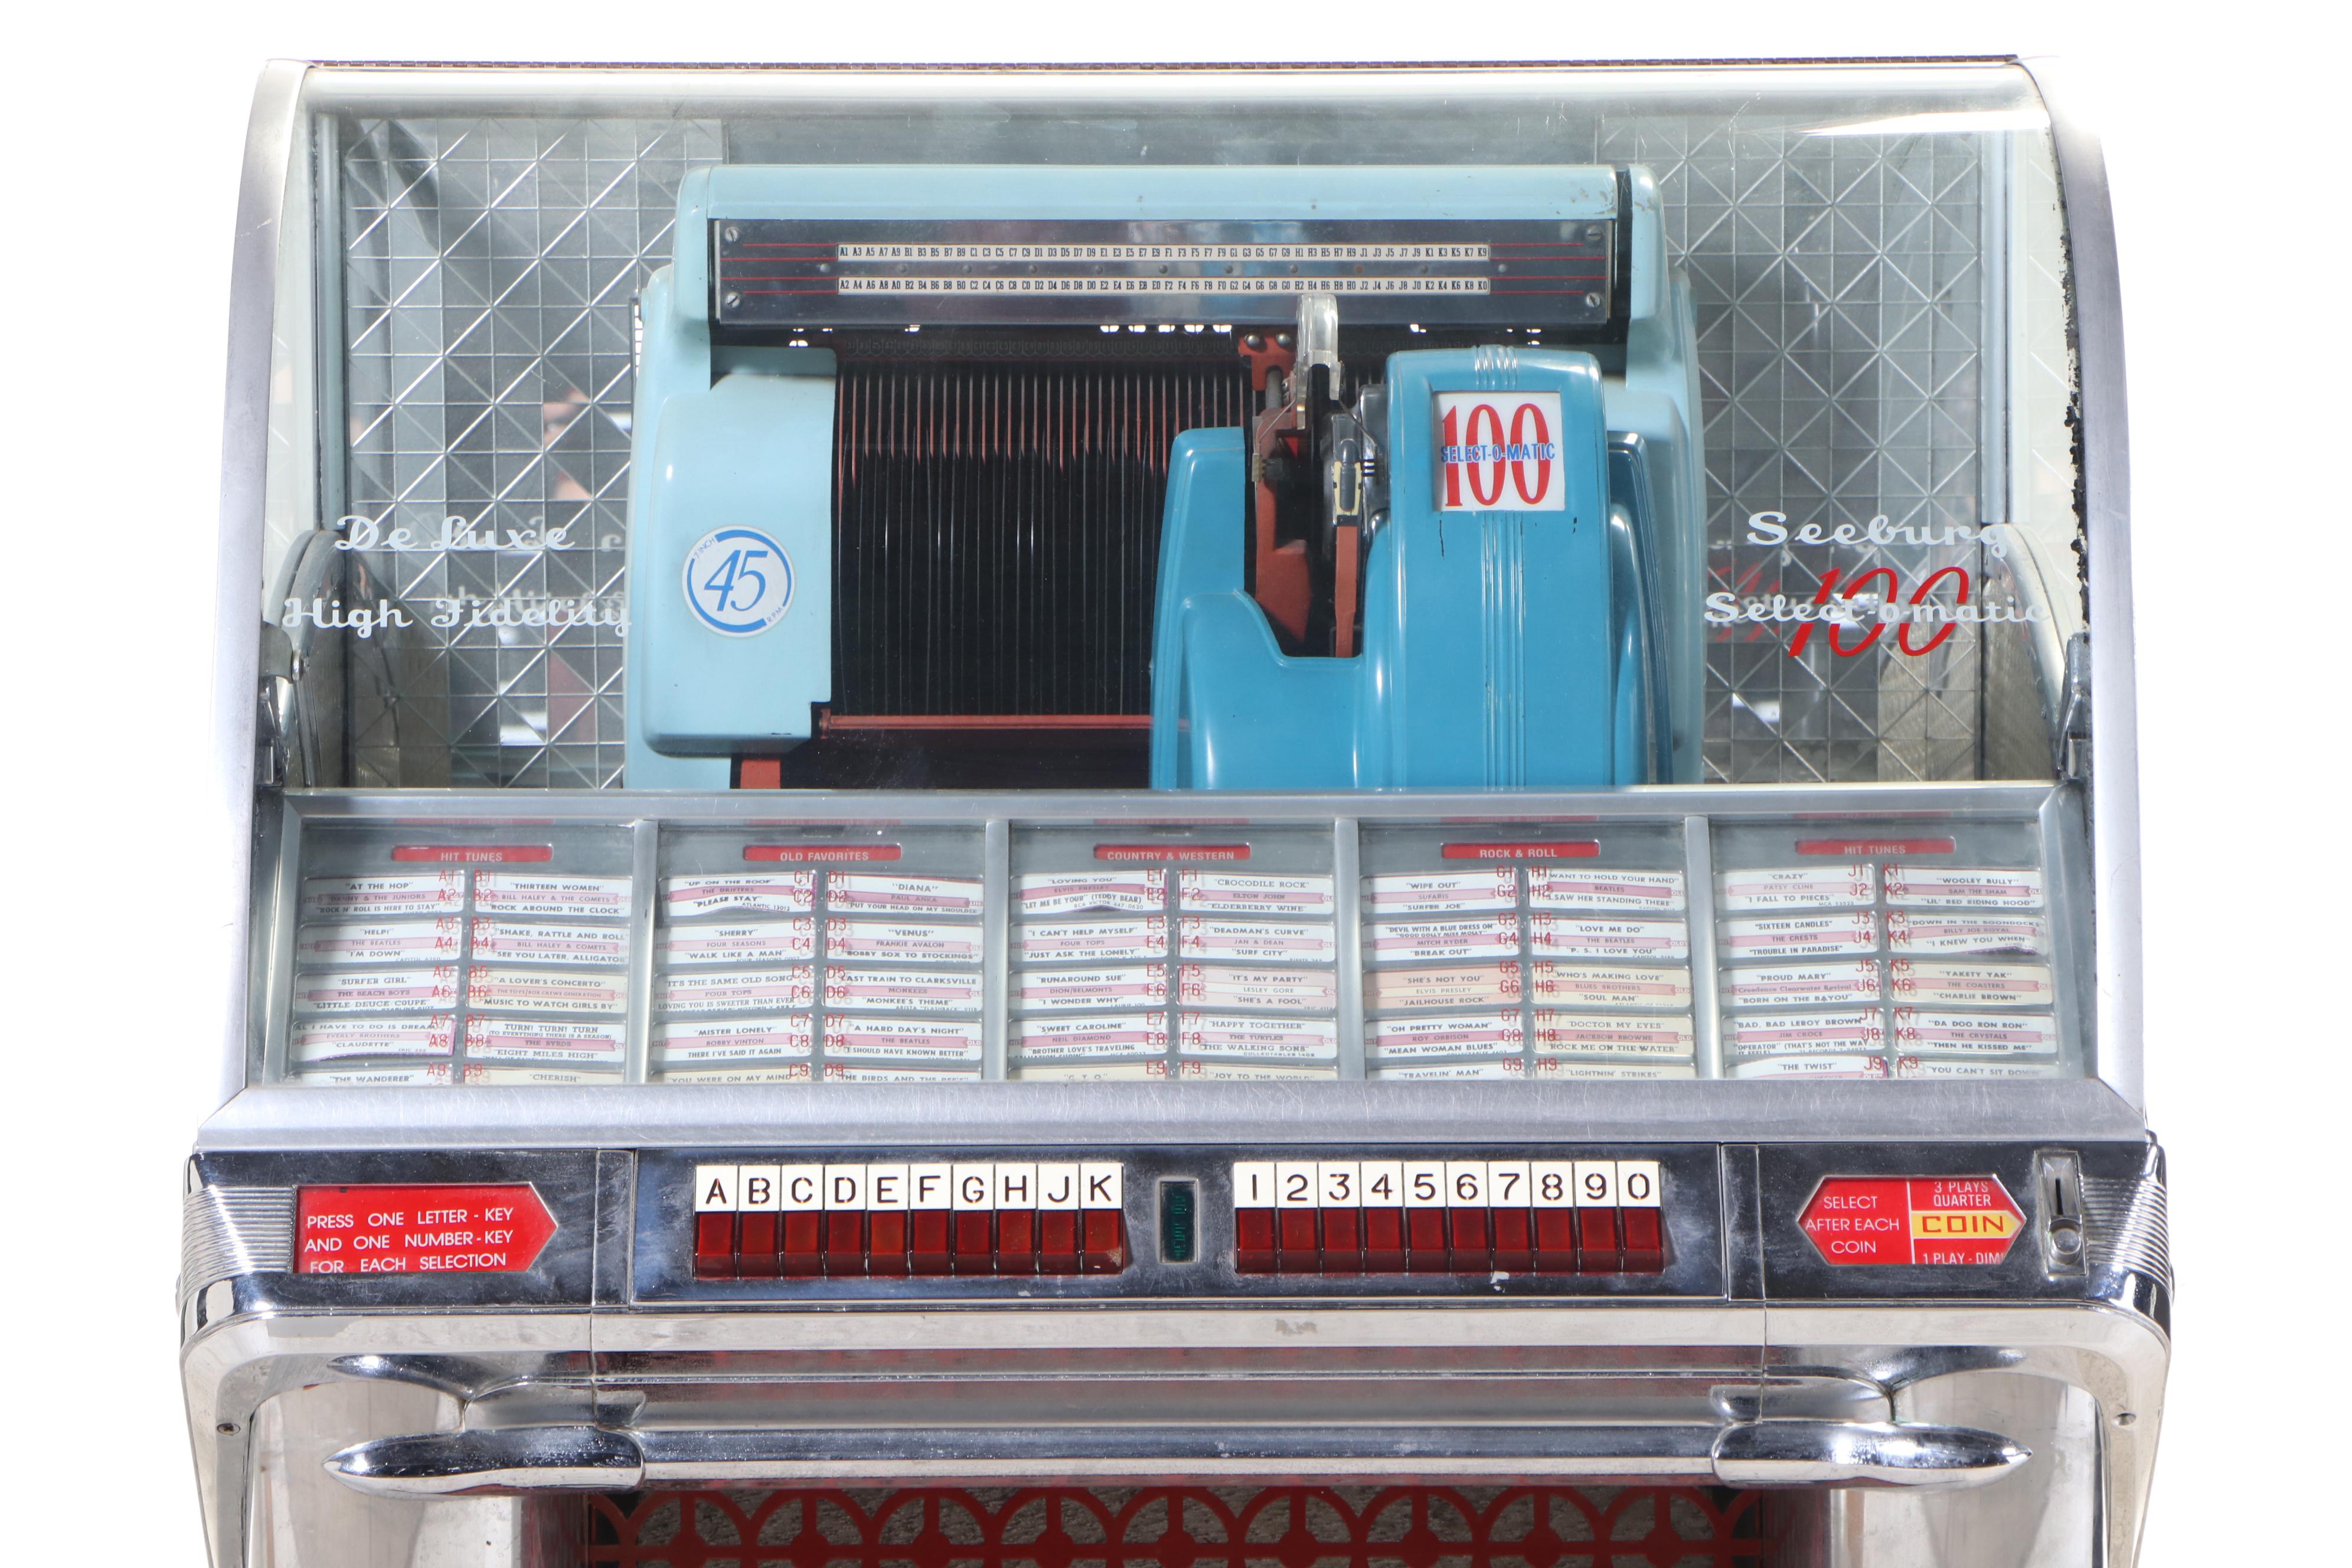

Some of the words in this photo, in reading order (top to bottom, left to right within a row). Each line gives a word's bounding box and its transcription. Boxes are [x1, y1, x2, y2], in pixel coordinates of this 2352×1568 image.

[840, 247, 848, 256] A1
[853, 247, 861, 256] A3
[866, 247, 874, 256] A5
[880, 247, 888, 256] A7
[892, 247, 900, 256] A9
[905, 248, 912, 256] B1
[918, 248, 926, 256] B3
[931, 248, 939, 257] B5
[1373, 281, 1381, 290] J4
[1386, 281, 1394, 290] J6
[1399, 281, 1407, 290] J8
[1412, 281, 1421, 290] J0
[1426, 281, 1435, 290] K2
[1439, 281, 1447, 290] K4
[1452, 281, 1461, 290] K6
[1465, 281, 1474, 290] K8
[1478, 281, 1487, 290] K0
[1441, 443, 1555, 462] SELECT-O-MATIC
[1442, 403, 1550, 507] 100
[431, 515, 575, 550] Luxe
[1747, 511, 2007, 558] Seeburg
[704, 550, 768, 611] 45
[283, 597, 413, 639] High
[431, 595, 632, 637] Fidelity
[1788, 567, 1969, 658] 100
[441, 852, 462, 862] HIT
[465, 852, 502, 862] TUNES
[780, 852, 803, 861] OLD
[808, 852, 868, 861] FAVORITES
[1108, 851, 1161, 860] COUNTRY
[1167, 851, 1174, 860] &
[1180, 852, 1234, 860] WESTERN
[1480, 850, 1510, 858] ROCK
[1516, 849, 1523, 857] &
[1528, 848, 1557, 857] ROLL
[1844, 846, 1866, 854] HIT
[1870, 846, 1906, 854] TUNES
[534, 1050, 564, 1059] MILES
[706, 1178, 727, 1204] A
[749, 1178, 770, 1204] B
[791, 1178, 813, 1203] C
[835, 1177, 857, 1203] D
[877, 1177, 898, 1203] E
[920, 1176, 941, 1202] F
[962, 1177, 984, 1203] G
[1005, 1176, 1027, 1202] H
[1047, 1176, 1069, 1202] J
[1090, 1176, 1112, 1202] K
[1252, 1175, 1256, 1201] 1
[1286, 1174, 1308, 1201] 2
[1329, 1174, 1350, 1201] 3
[1371, 1174, 1393, 1200] 4
[1415, 1174, 1436, 1200] 5
[1456, 1174, 1478, 1201] 6
[1498, 1174, 1520, 1200] 7
[1541, 1174, 1563, 1201] 8
[1585, 1174, 1606, 1200] 9
[1628, 1174, 1650, 1199] 0
[1935, 1182, 1942, 1193] 3
[1949, 1182, 1988, 1193] PLAYS
[1824, 1196, 1877, 1209] SELECT
[1933, 1194, 1991, 1207] QUARTER
[308, 1214, 354, 1229] PRESS
[368, 1212, 404, 1226] ONE
[417, 1210, 467, 1224] LETTER
[485, 1208, 514, 1221] KEY
[1806, 1220, 1850, 1231] AFTER
[1856, 1218, 1899, 1231] EACH
[1922, 1216, 2004, 1233] COIN
[304, 1237, 341, 1252] AND
[354, 1235, 390, 1249] ONE
[1831, 1240, 1876, 1254] COIN
[311, 1260, 344, 1273] FOR
[360, 1257, 406, 1271] EACH
[420, 1253, 506, 1269] SELECTION
[1923, 1253, 1928, 1264] 1
[1934, 1252, 1963, 1264] PLAY
